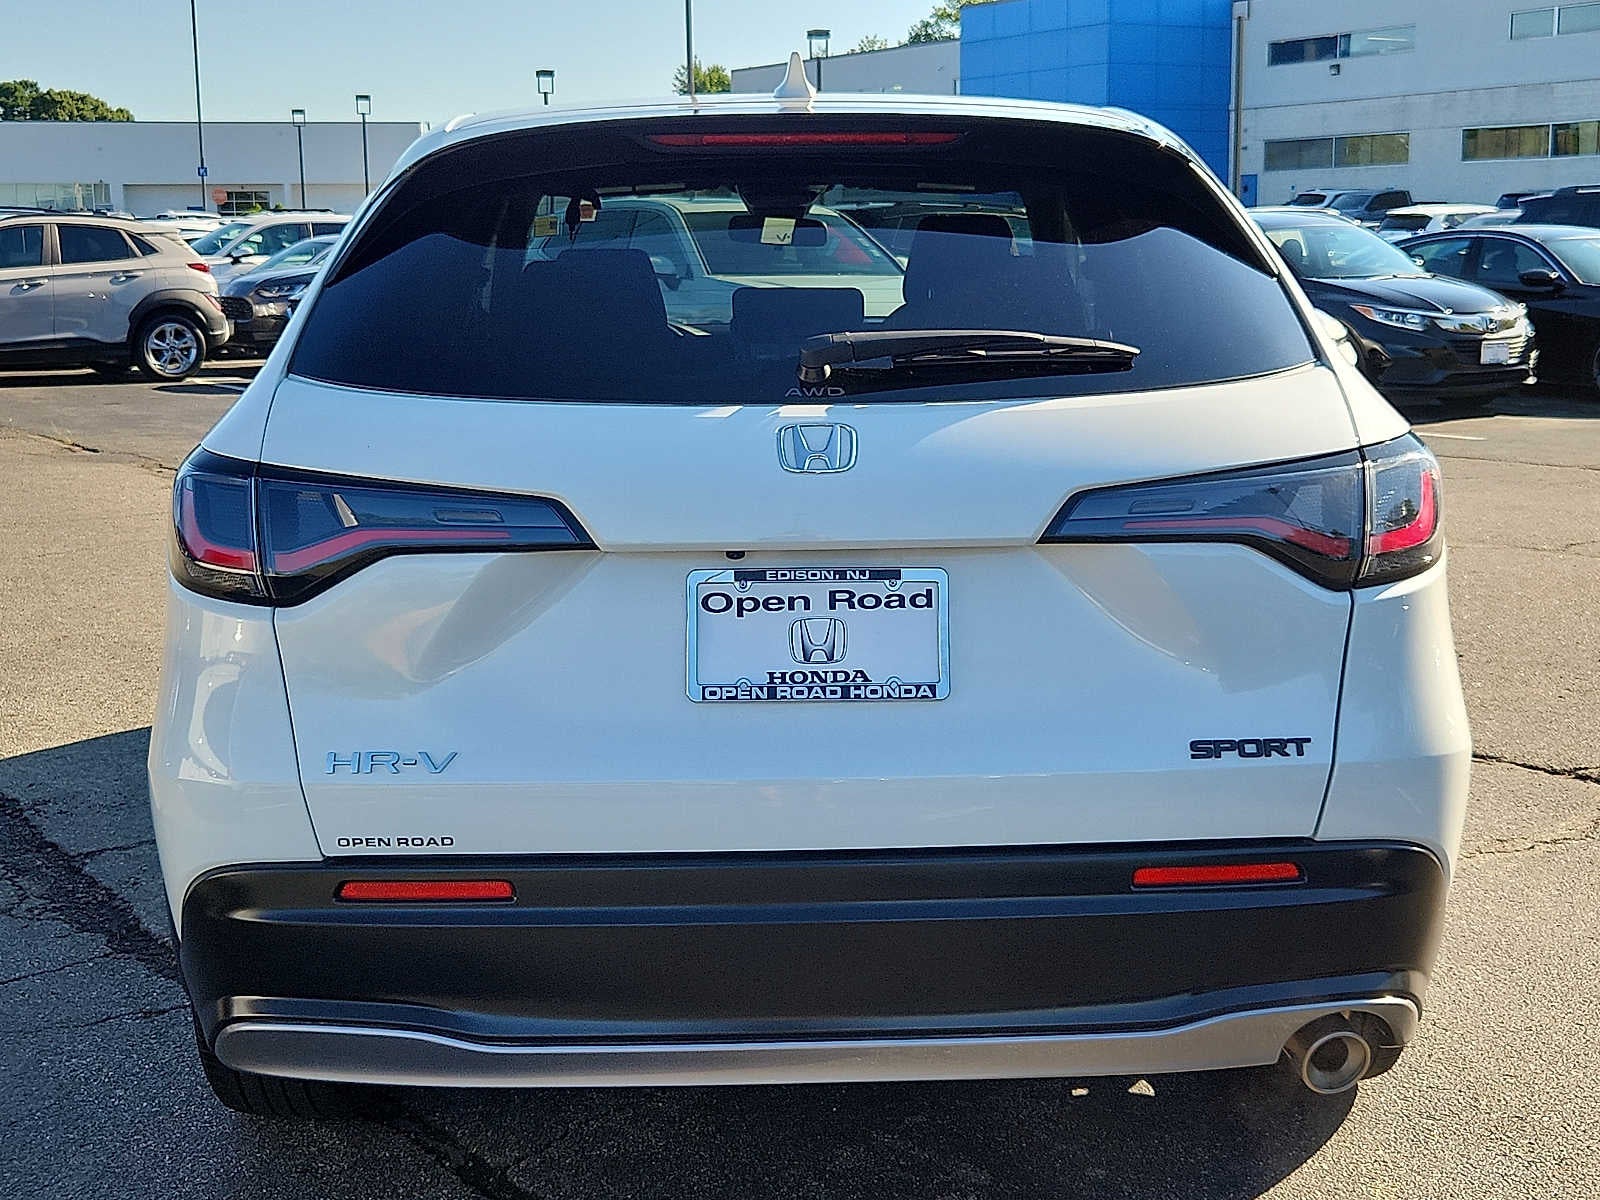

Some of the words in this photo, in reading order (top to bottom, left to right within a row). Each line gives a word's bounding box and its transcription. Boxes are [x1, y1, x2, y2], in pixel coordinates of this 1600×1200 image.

[785, 387, 846, 397] AWD
[766, 570, 839, 581] EDISON,
[846, 570, 871, 580] NJ
[701, 592, 812, 618] Open
[828, 588, 934, 611] Road
[766, 670, 872, 685] HONDA
[704, 686, 768, 700] OPEN
[776, 686, 841, 699] ROAD
[850, 685, 934, 698] HONDA
[1190, 737, 1312, 759] SPORT
[325, 751, 459, 775] HR-V
[337, 837, 391, 847] OPEN
[397, 836, 454, 847] ROAD
